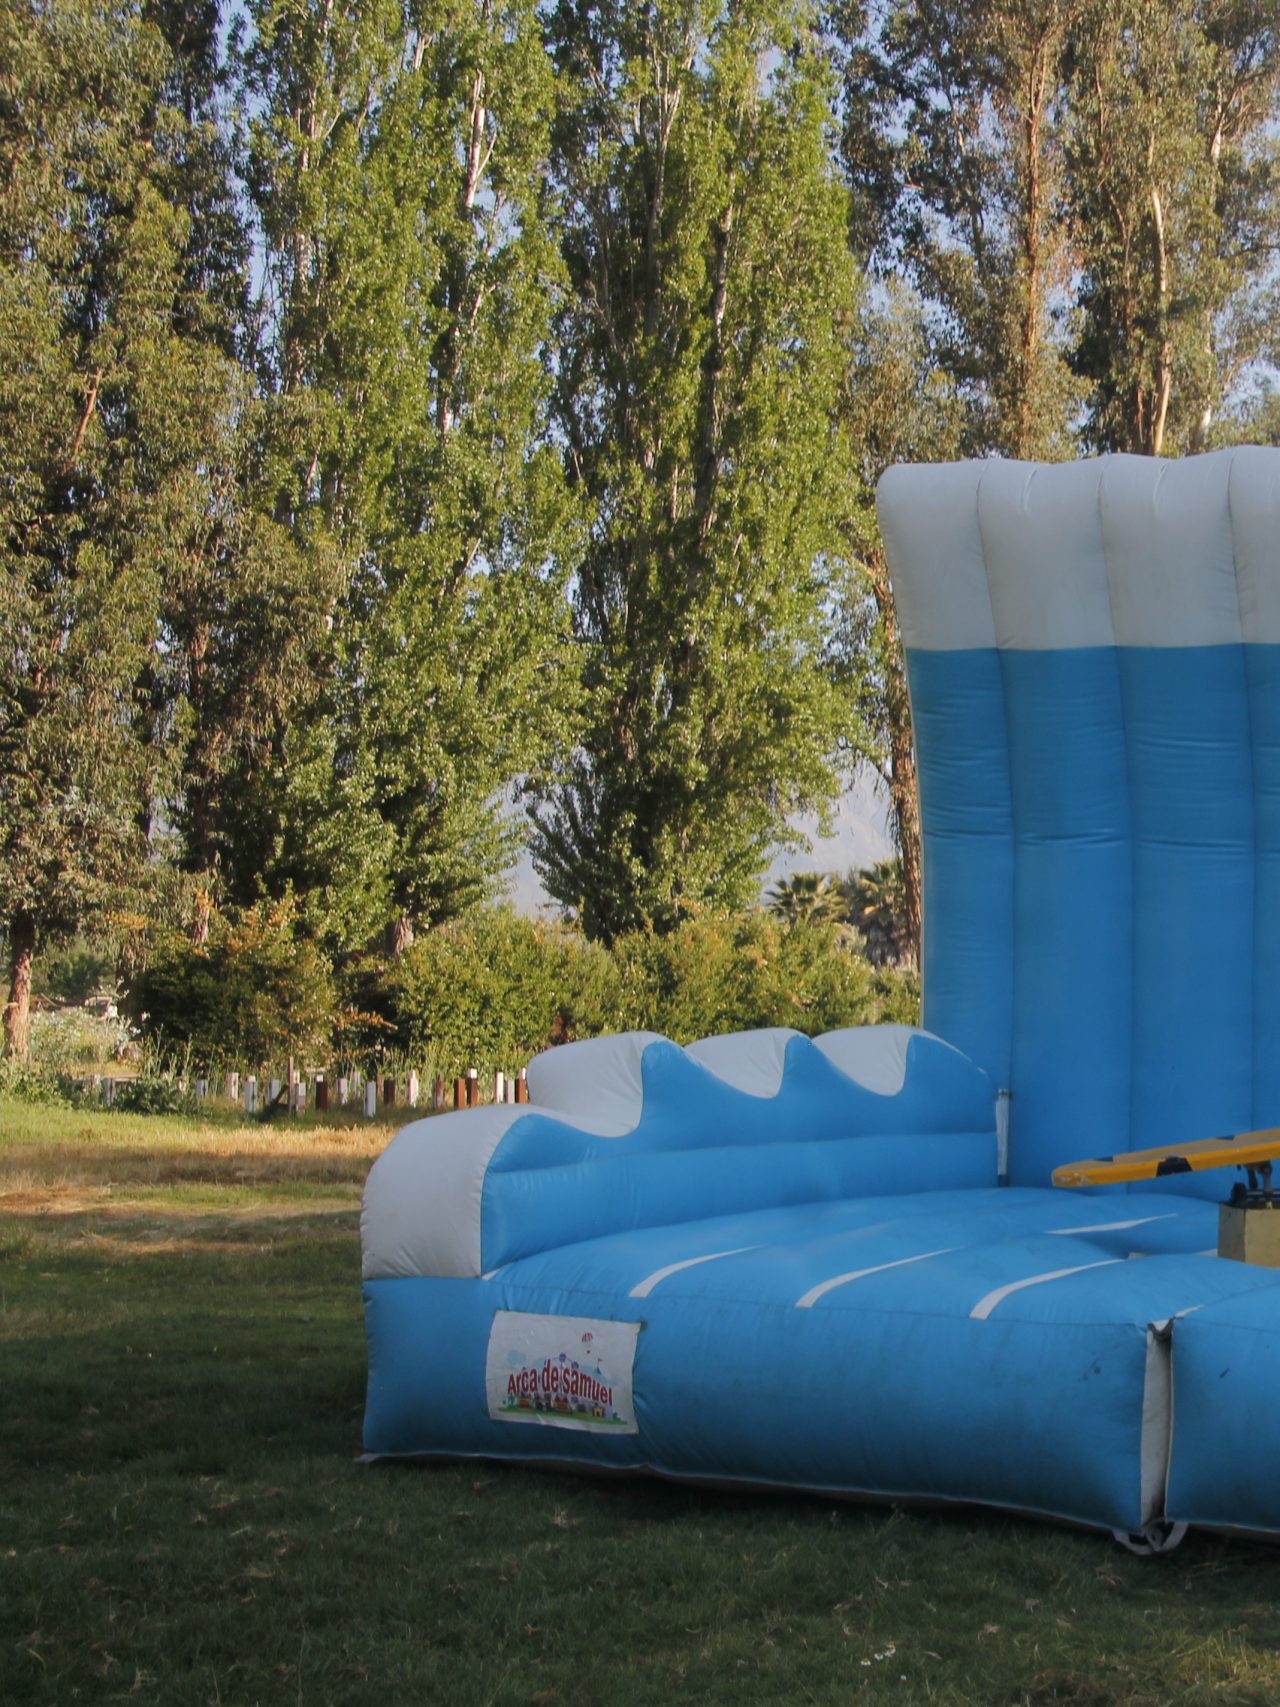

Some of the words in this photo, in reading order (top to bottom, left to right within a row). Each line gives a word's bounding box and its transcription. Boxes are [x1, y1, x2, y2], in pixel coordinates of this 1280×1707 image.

[508, 1368, 538, 1394] Arca
[541, 1360, 559, 1393] de
[562, 1368, 613, 1406] samuel
